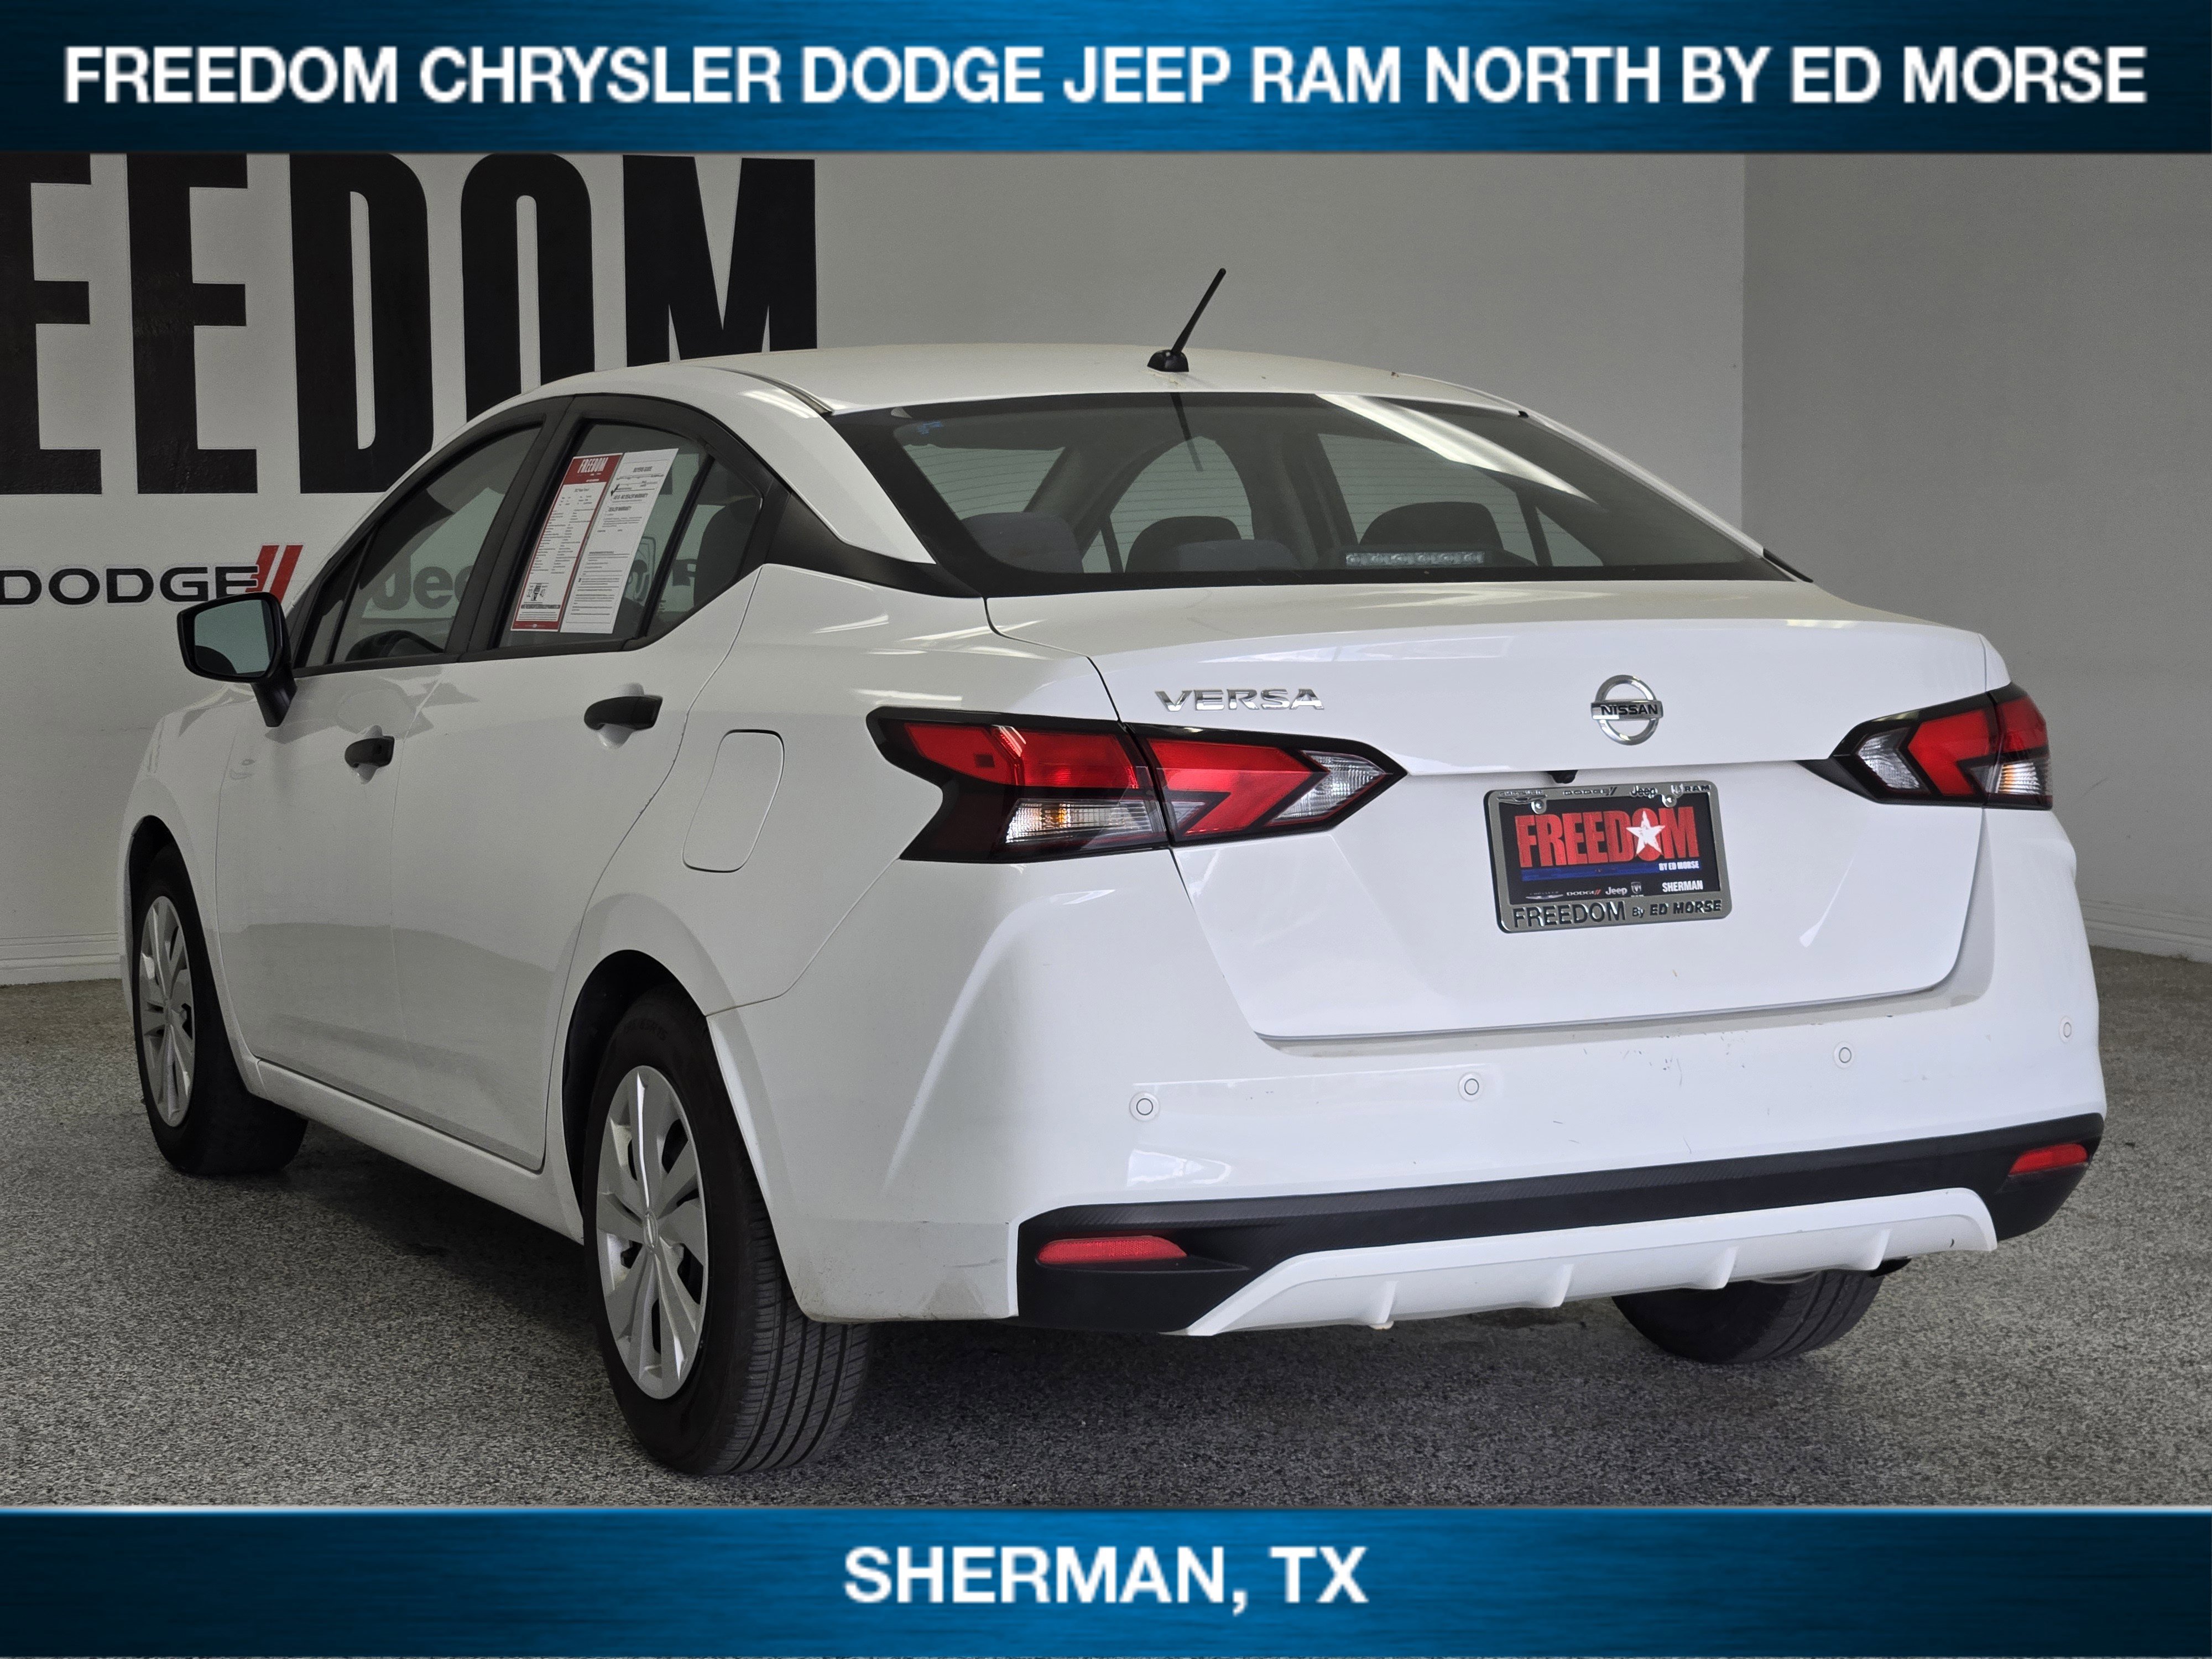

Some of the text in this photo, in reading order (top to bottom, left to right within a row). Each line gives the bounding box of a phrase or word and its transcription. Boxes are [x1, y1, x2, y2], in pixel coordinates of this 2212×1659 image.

[577, 457, 608, 473] FREEDOM
[0, 566, 259, 605] DODGE
[1155, 688, 1325, 712] VERSA
[1600, 704, 1658, 716] NISSAN
[1630, 785, 1658, 799] Jeep
[1684, 784, 1711, 793] RAM
[1514, 806, 1700, 868] FREEDOM
[1669, 862, 1677, 870] ED
[1677, 861, 1699, 870] MORSE
[1605, 886, 1628, 896] Jeep
[1662, 880, 1704, 893] SHERMAN
[1512, 899, 1722, 928] FREEDOM By ED MORSE
